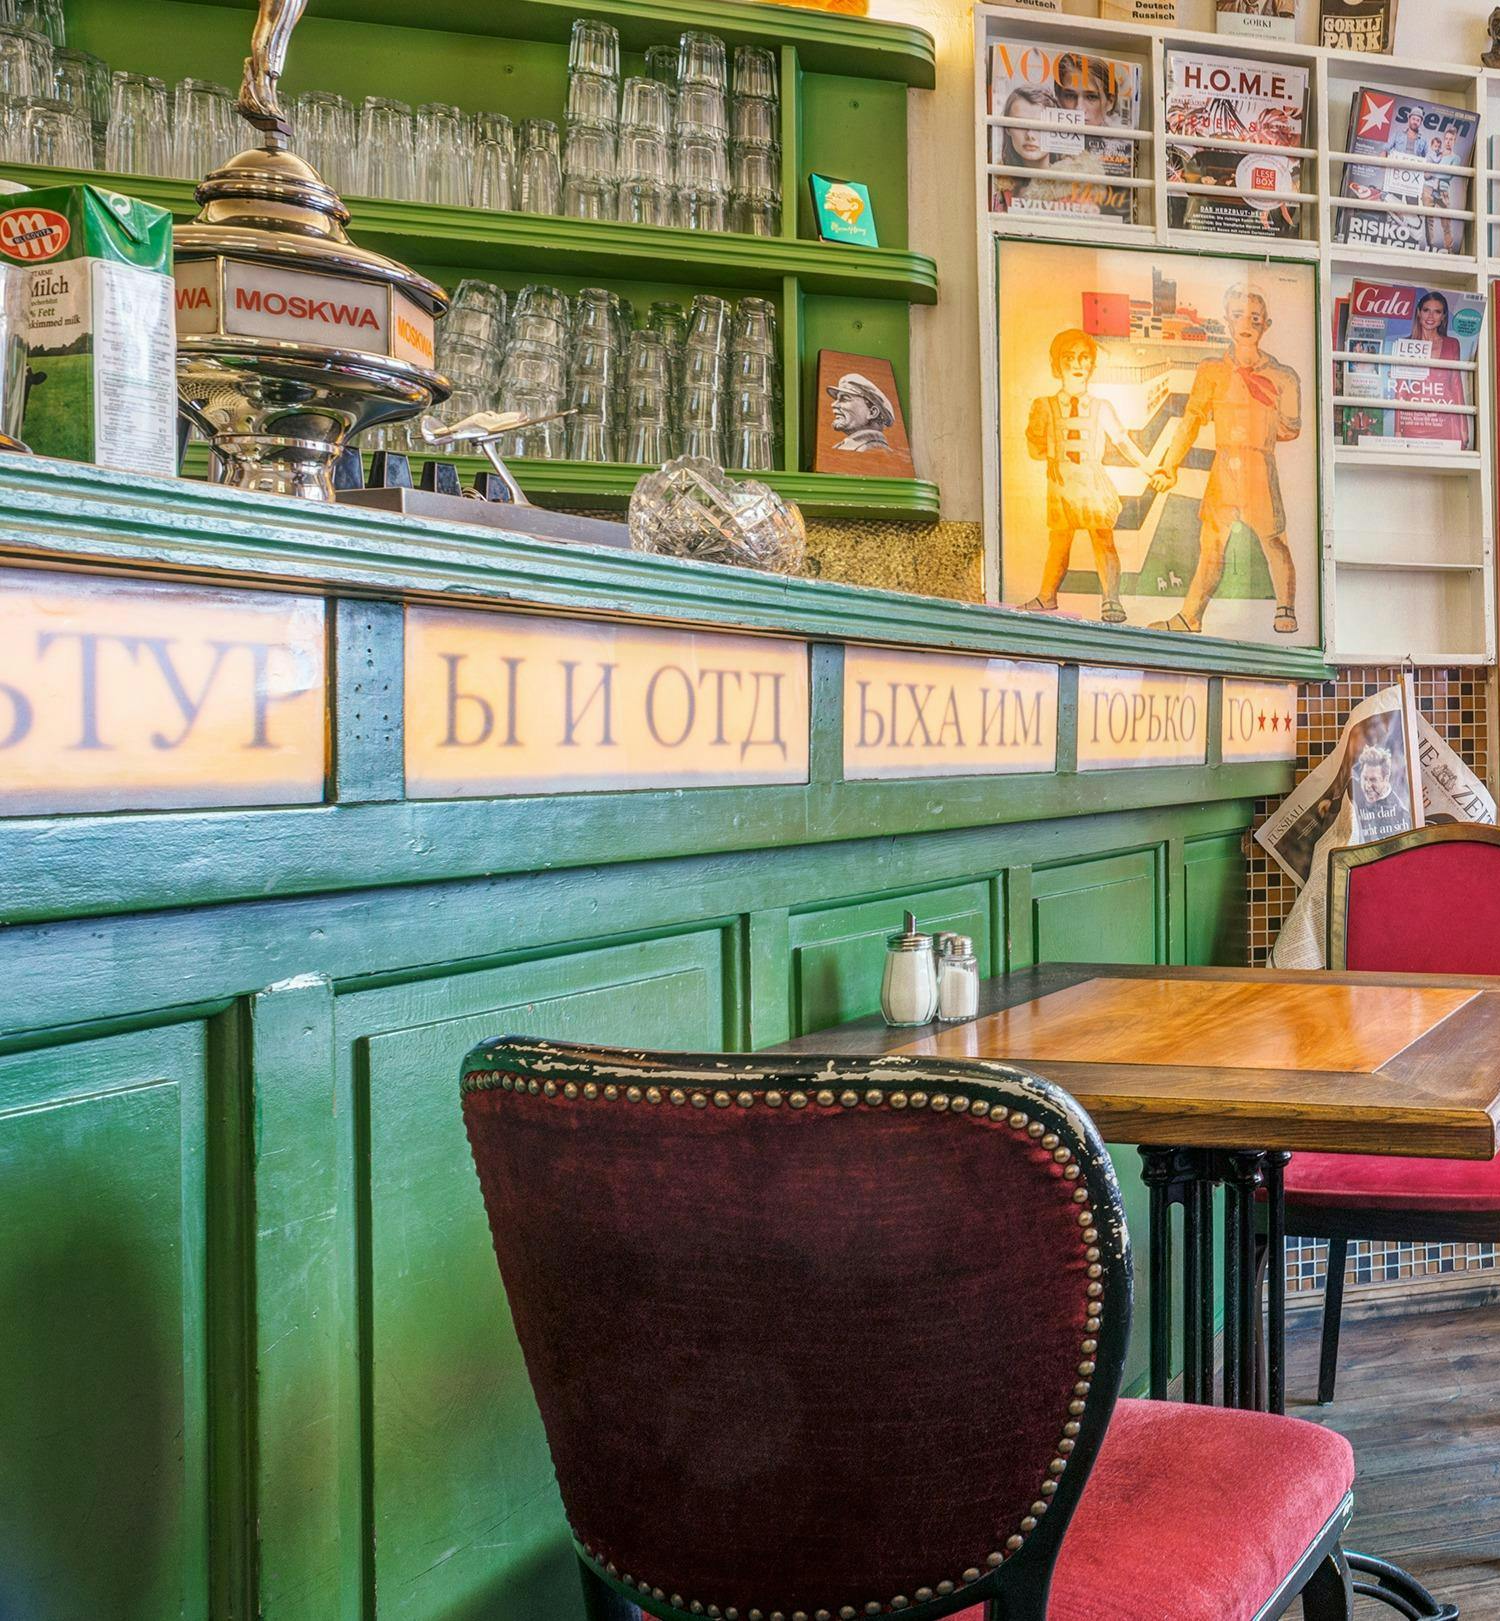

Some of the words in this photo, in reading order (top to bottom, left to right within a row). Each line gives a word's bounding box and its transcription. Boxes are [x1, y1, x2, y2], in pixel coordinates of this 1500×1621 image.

[1132, 11, 1175, 20] Russisch
[1135, 1, 1175, 10] Deutsch
[1243, 18, 1272, 28] GORKI
[1324, 17, 1381, 32] GORKIJ
[1323, 32, 1381, 51] PARK
[998, 43, 1134, 97] VOGUE
[1184, 66, 1293, 100] H.O.M.E.
[1177, 114, 1237, 132] FEUER
[1395, 105, 1472, 138] sern
[1255, 169, 1275, 179] LESE
[1255, 177, 1274, 187] BOX
[1349, 217, 1412, 241] RISIKO
[38, 307, 55, 317] Fett
[235, 287, 381, 331] MOSKWA
[1356, 287, 1410, 316] Gala
[64, 315, 80, 325] milk
[396, 315, 433, 359] MOSKWA
[1400, 341, 1429, 355] LESE
[1387, 379, 1445, 396] RACHE
[644, 662, 789, 764] ОТД
[977, 687, 1044, 748] ИМ
[1089, 690, 1198, 746] ГОРЬКО
[1226, 696, 1255, 743] ГО
[1377, 804, 1397, 818] darf
[1452, 784, 1497, 825] ZEIT
[1266, 802, 1306, 845] FUSSBALL
